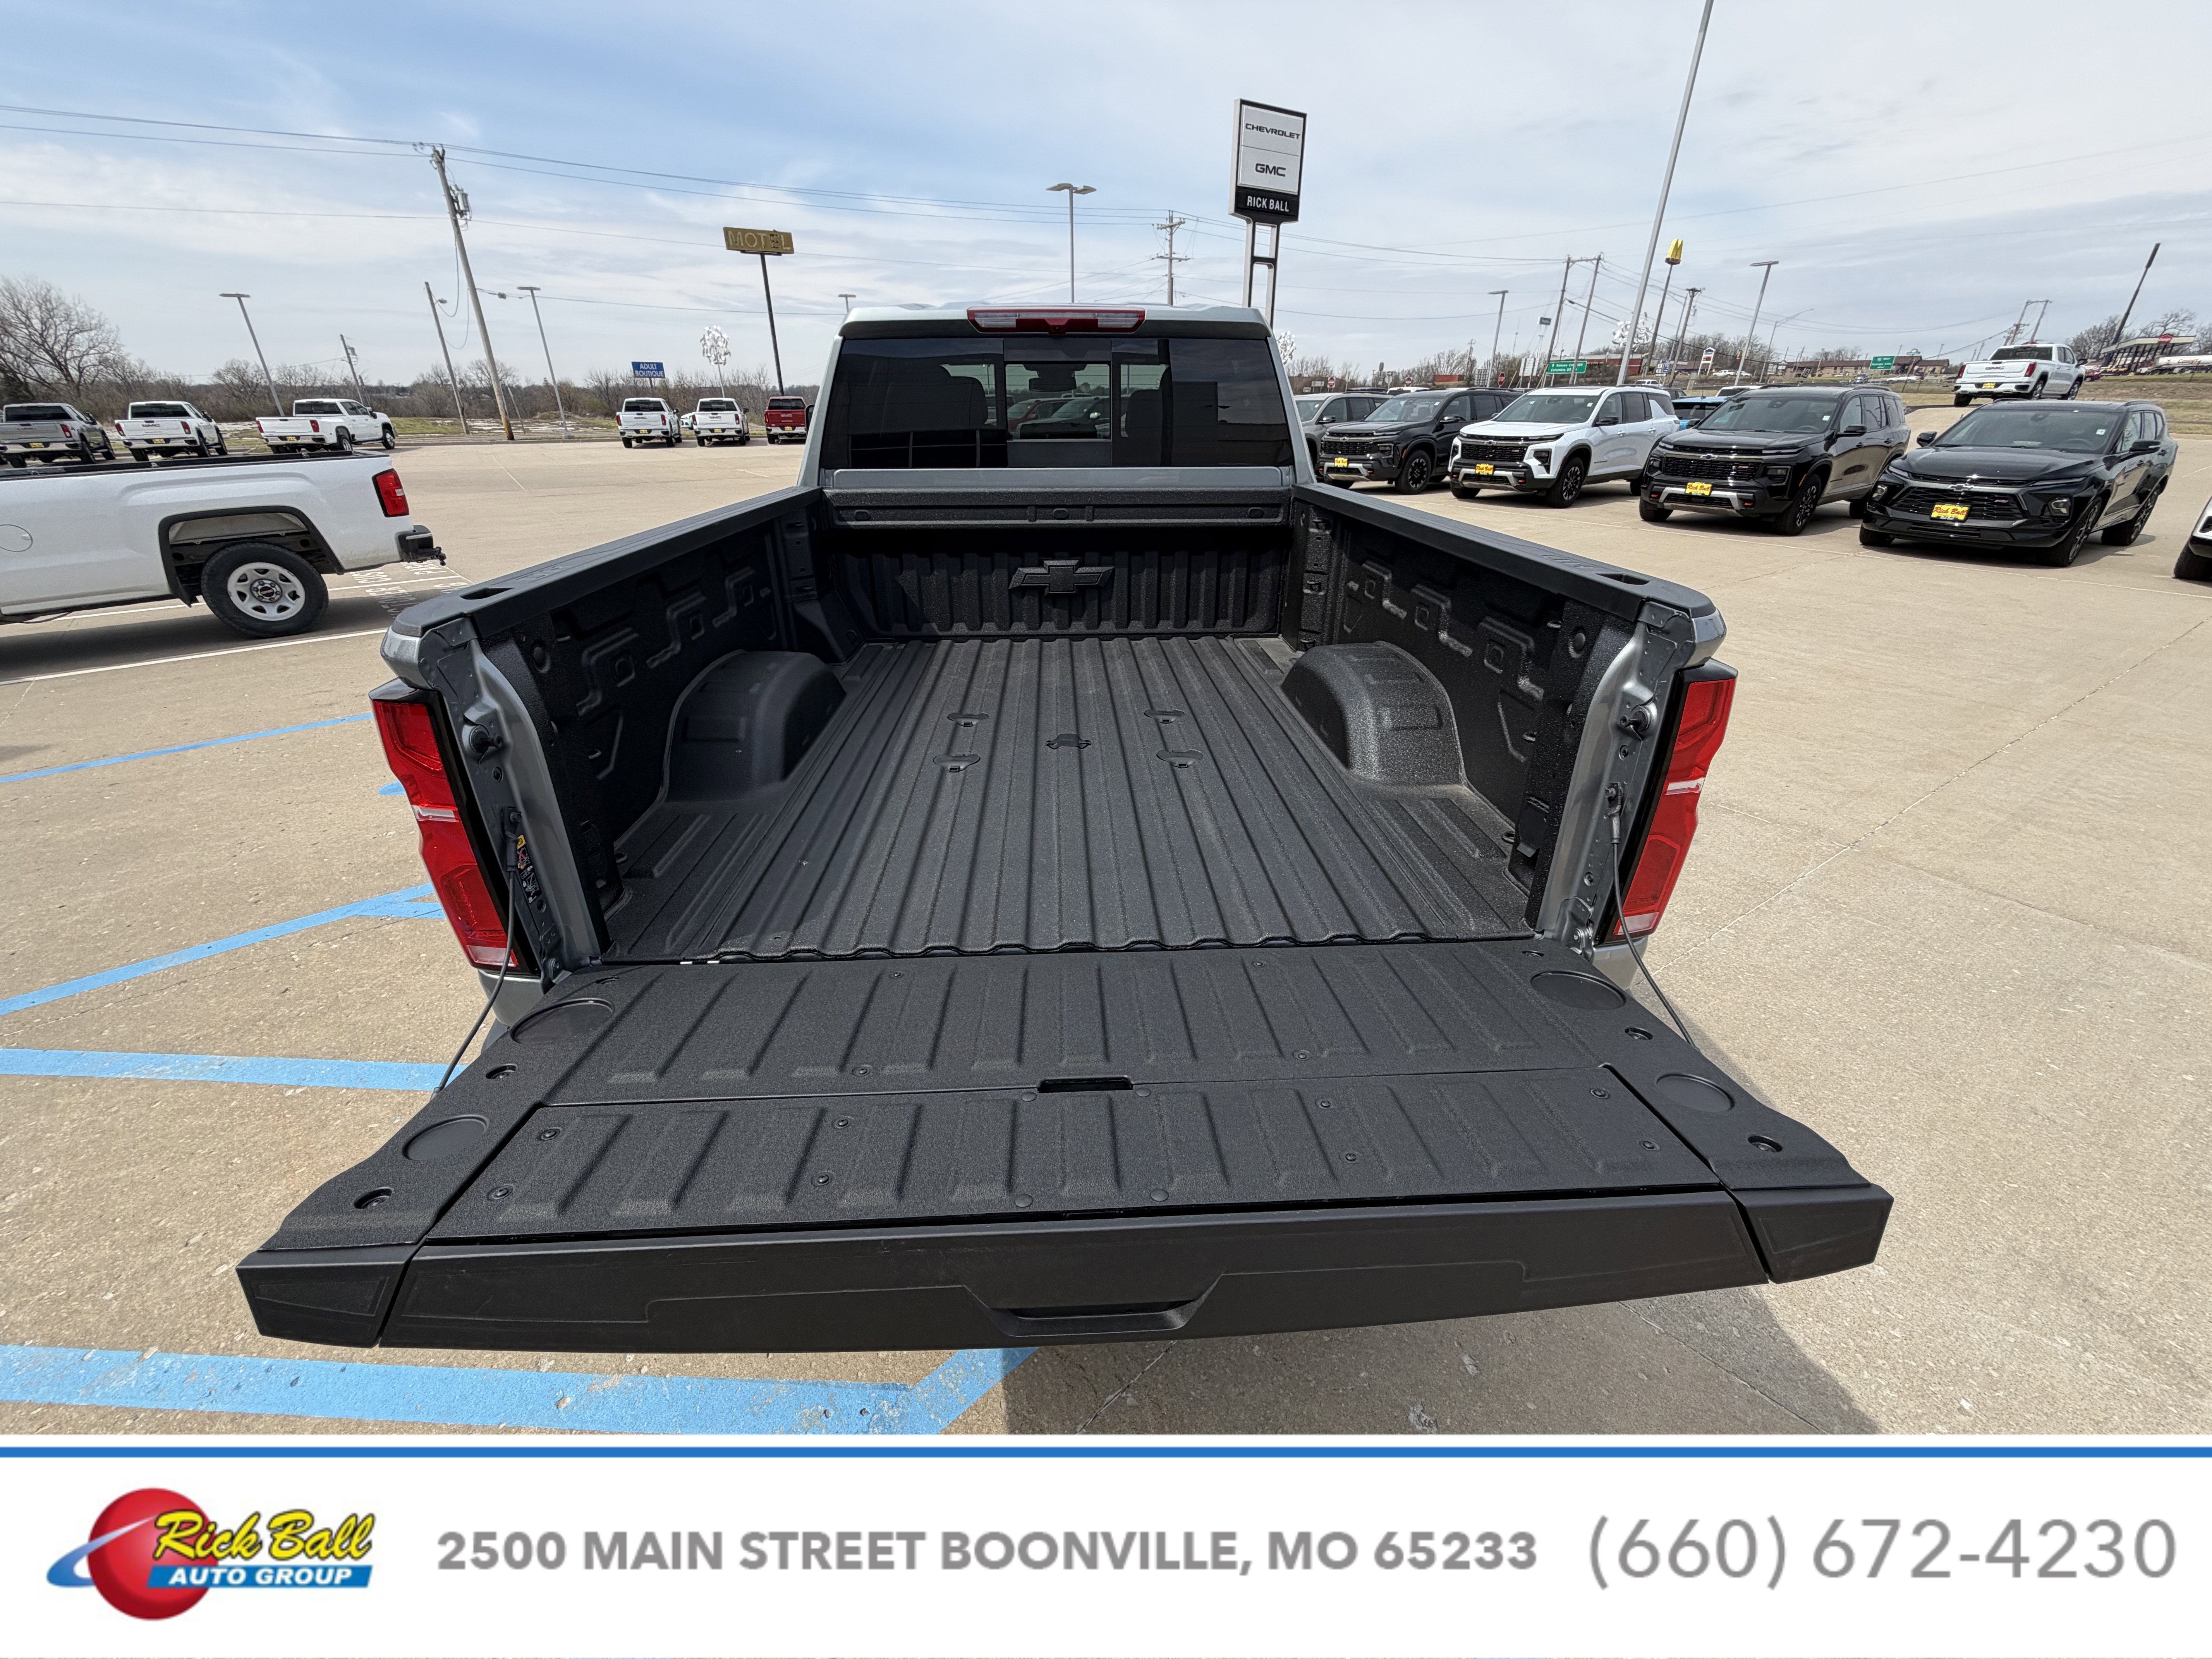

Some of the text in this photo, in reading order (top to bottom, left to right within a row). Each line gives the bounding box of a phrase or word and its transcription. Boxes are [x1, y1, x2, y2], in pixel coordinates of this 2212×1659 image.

[1245, 123, 1300, 139] CHEVROLET
[1255, 163, 1286, 177] GMC
[1247, 196, 1289, 212] RICK BALL
[728, 230, 791, 250] MOTEL
[400, 560, 447, 575] PARK
[350, 569, 392, 583] CUST
